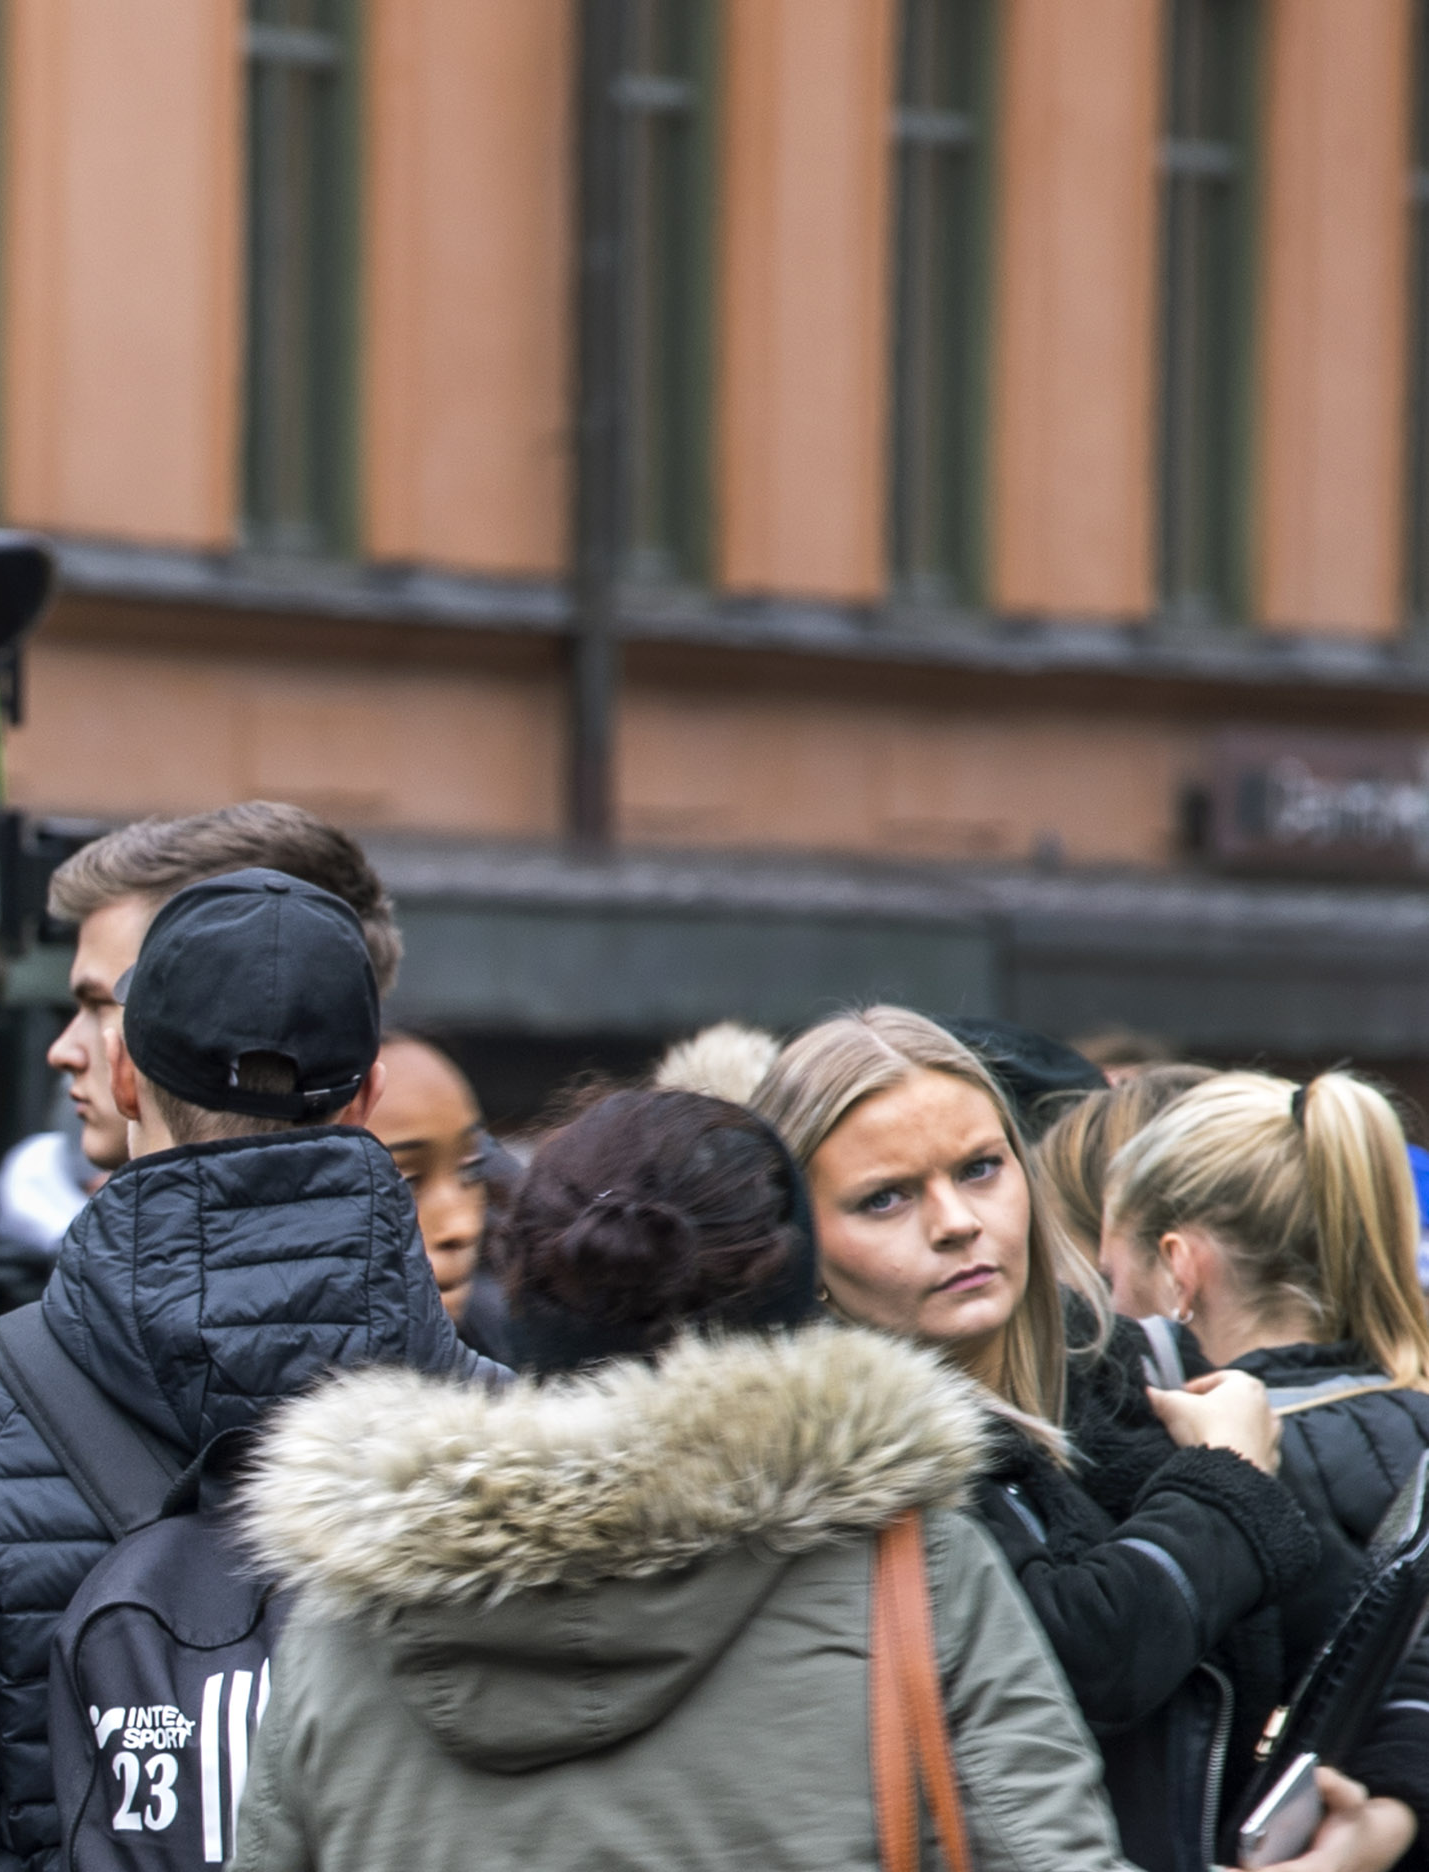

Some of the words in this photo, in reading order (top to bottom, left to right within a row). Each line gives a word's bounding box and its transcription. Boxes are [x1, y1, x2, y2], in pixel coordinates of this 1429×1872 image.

[126, 1704, 196, 1737] INTER
[122, 1727, 188, 1750] SPORT
[111, 1750, 179, 1832] 23
